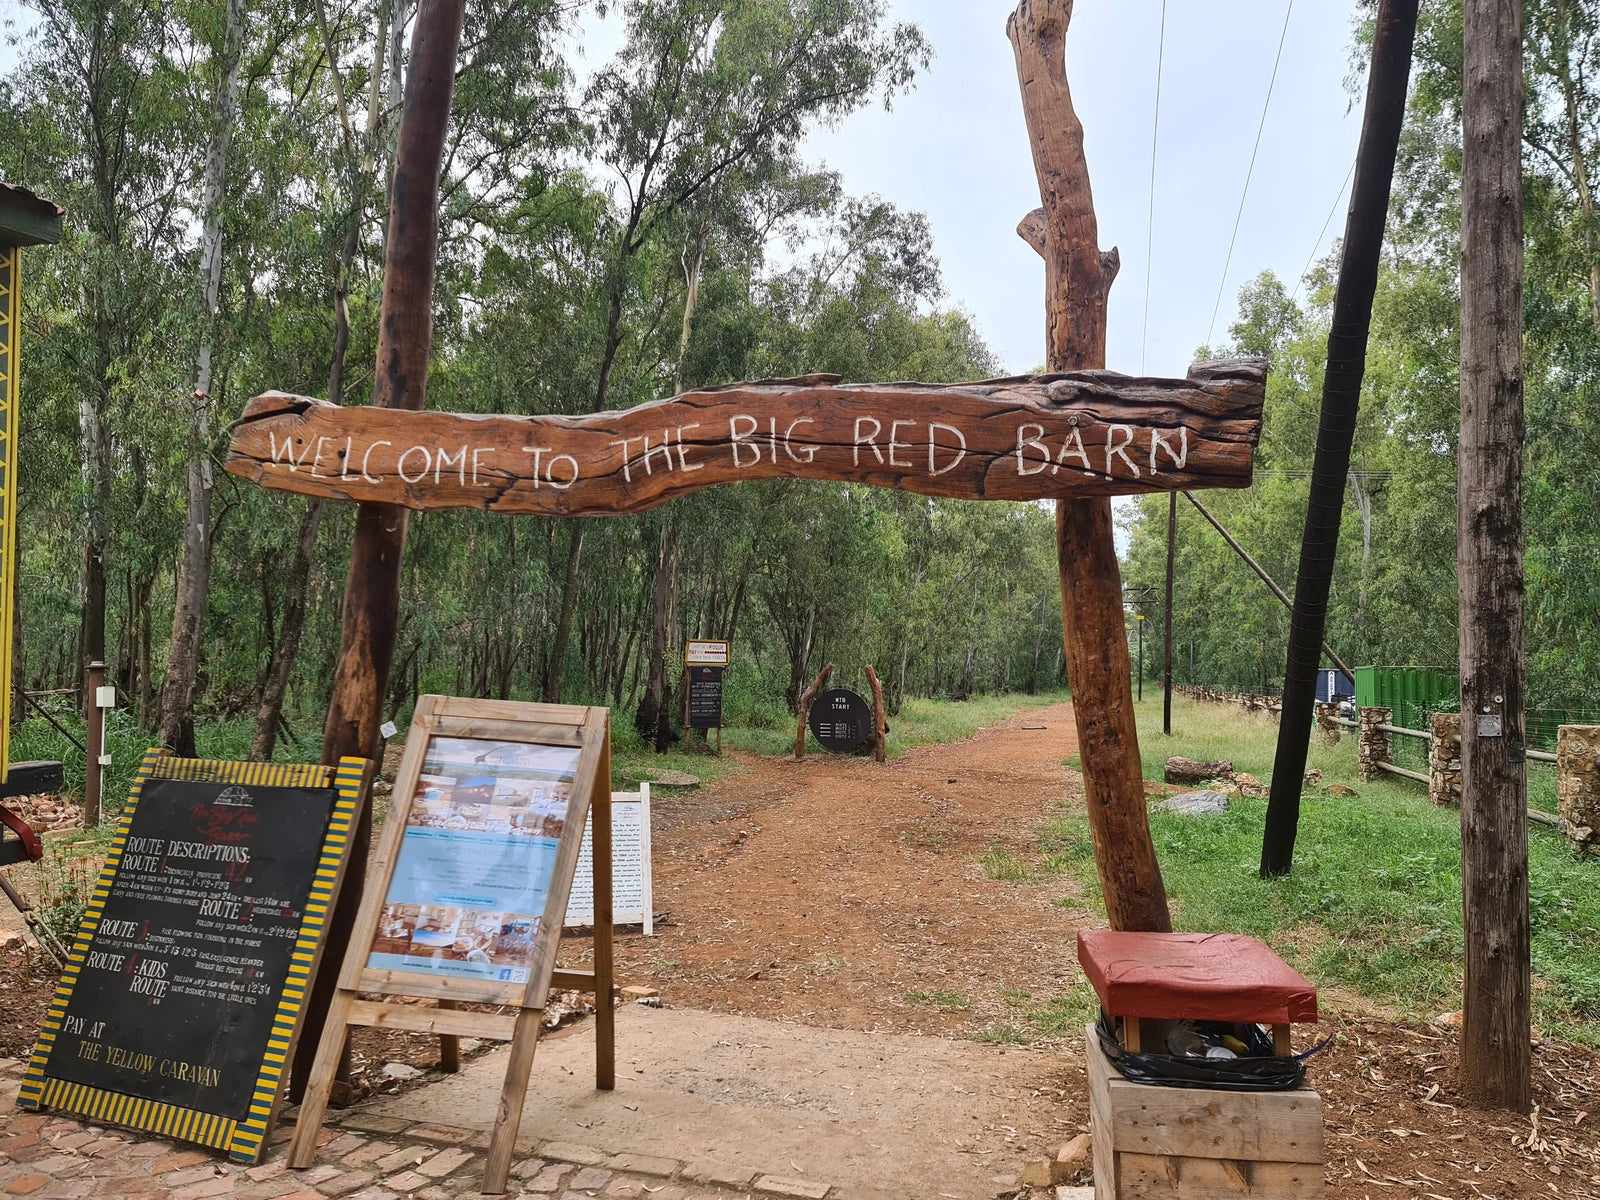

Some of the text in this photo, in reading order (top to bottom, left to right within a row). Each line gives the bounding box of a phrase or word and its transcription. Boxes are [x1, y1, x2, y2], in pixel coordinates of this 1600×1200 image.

[268, 414, 1188, 490] WELCOME TO THE BIG RED BARN
[127, 837, 251, 863] ROUTE DESCRIPTIONS:
[121, 854, 160, 873] ROUTE
[199, 898, 242, 920] ROUTE
[98, 918, 139, 938] ROUTE
[86, 951, 126, 972] ROUTE
[138, 959, 169, 978] KIDS
[129, 975, 170, 998] ROUTE
[63, 1015, 106, 1039] PAY AT
[77, 1040, 222, 1088] THE YELLOW CARAVAN
